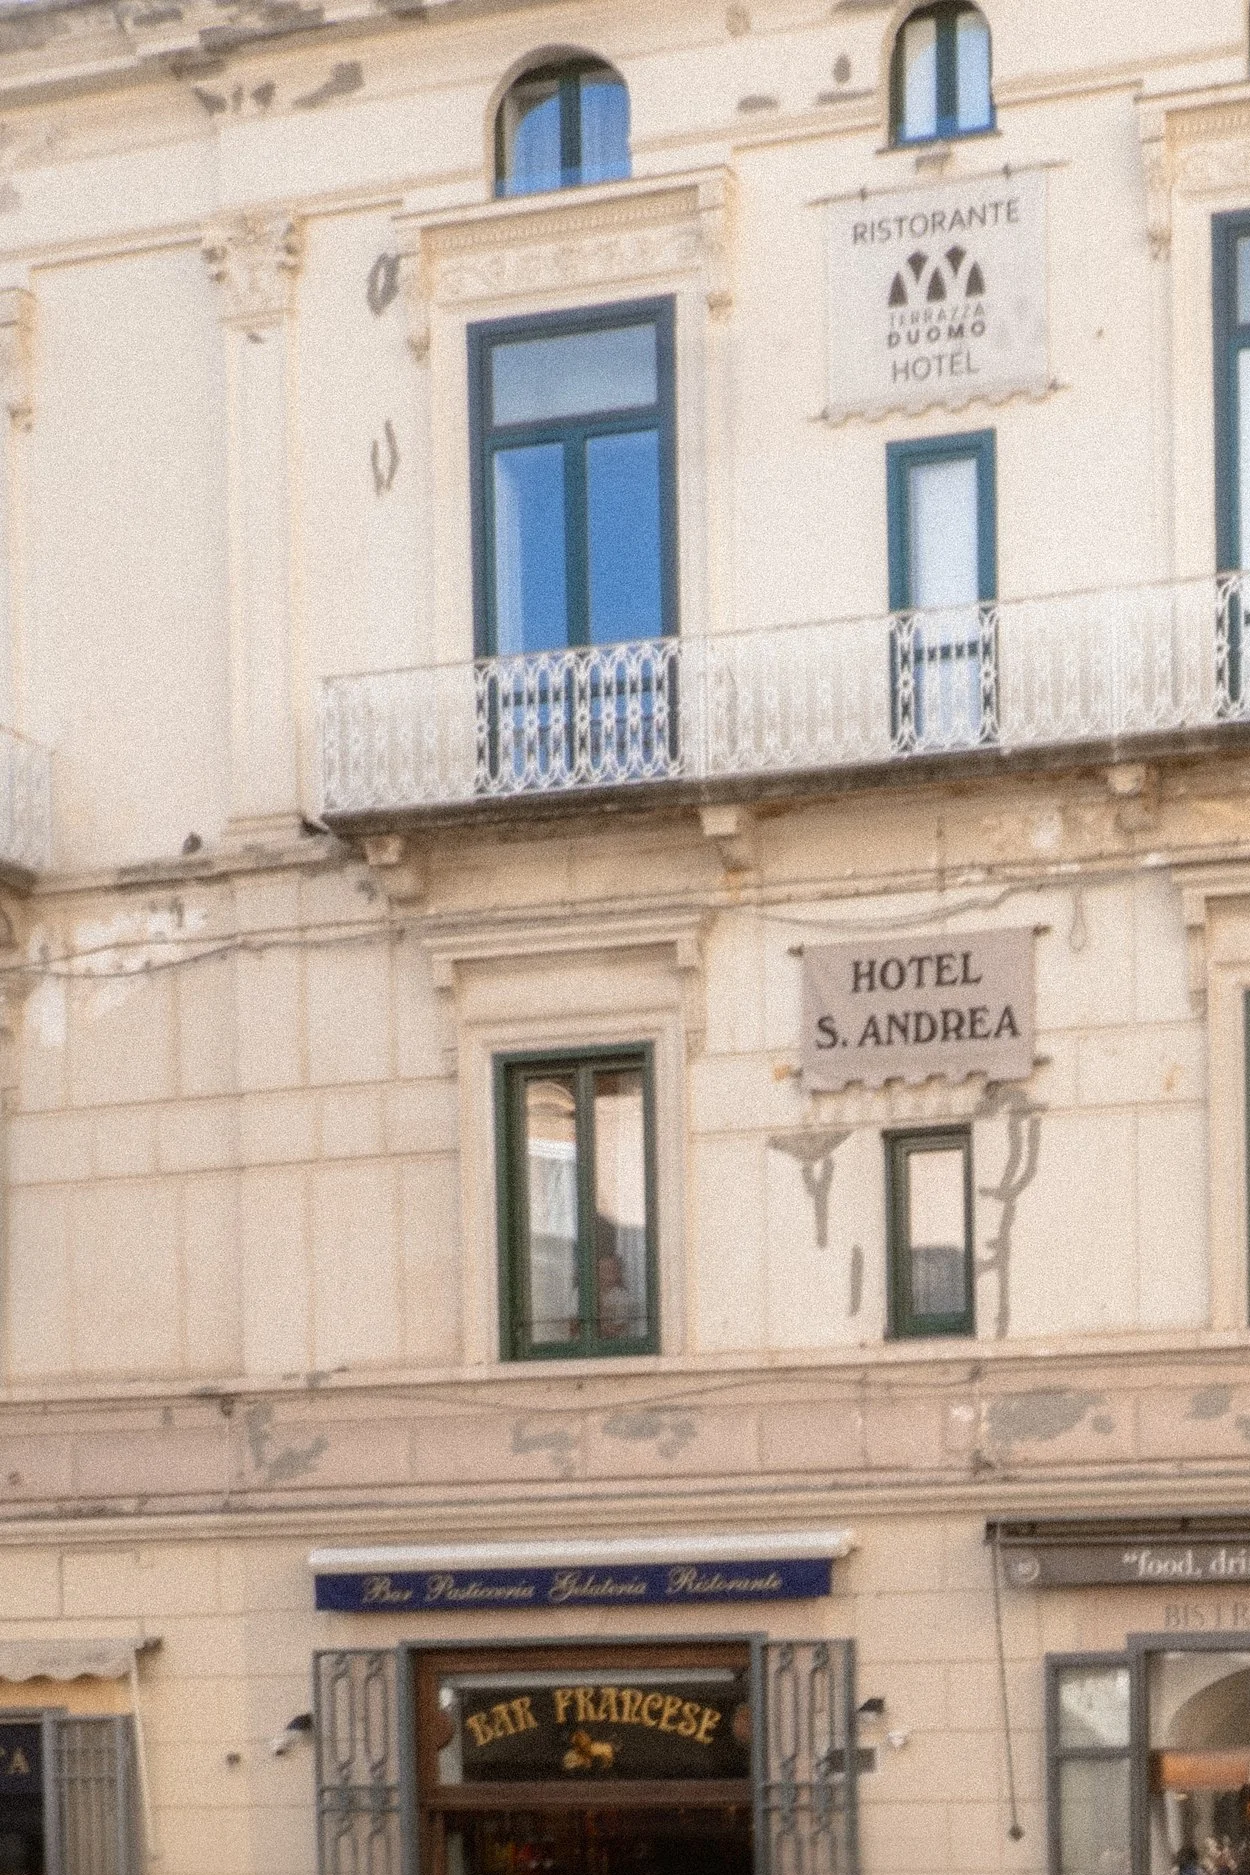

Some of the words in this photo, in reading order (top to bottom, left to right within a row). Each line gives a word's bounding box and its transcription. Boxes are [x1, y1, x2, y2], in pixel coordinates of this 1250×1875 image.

[852, 198, 1020, 245] RISTORANTE
[888, 320, 986, 349] DUOMO
[890, 303, 986, 328] TERRAZZA
[893, 350, 981, 383] HOTEL
[851, 951, 983, 993] HOTEL
[816, 1014, 848, 1050] S.
[857, 1003, 1021, 1048] ANDREA
[362, 1574, 413, 1602] Bar
[548, 1568, 648, 1602] Gelateria
[664, 1563, 783, 1596] Ristorante
[465, 1696, 539, 1747] BAR
[553, 1686, 722, 1744] FRANCESE
